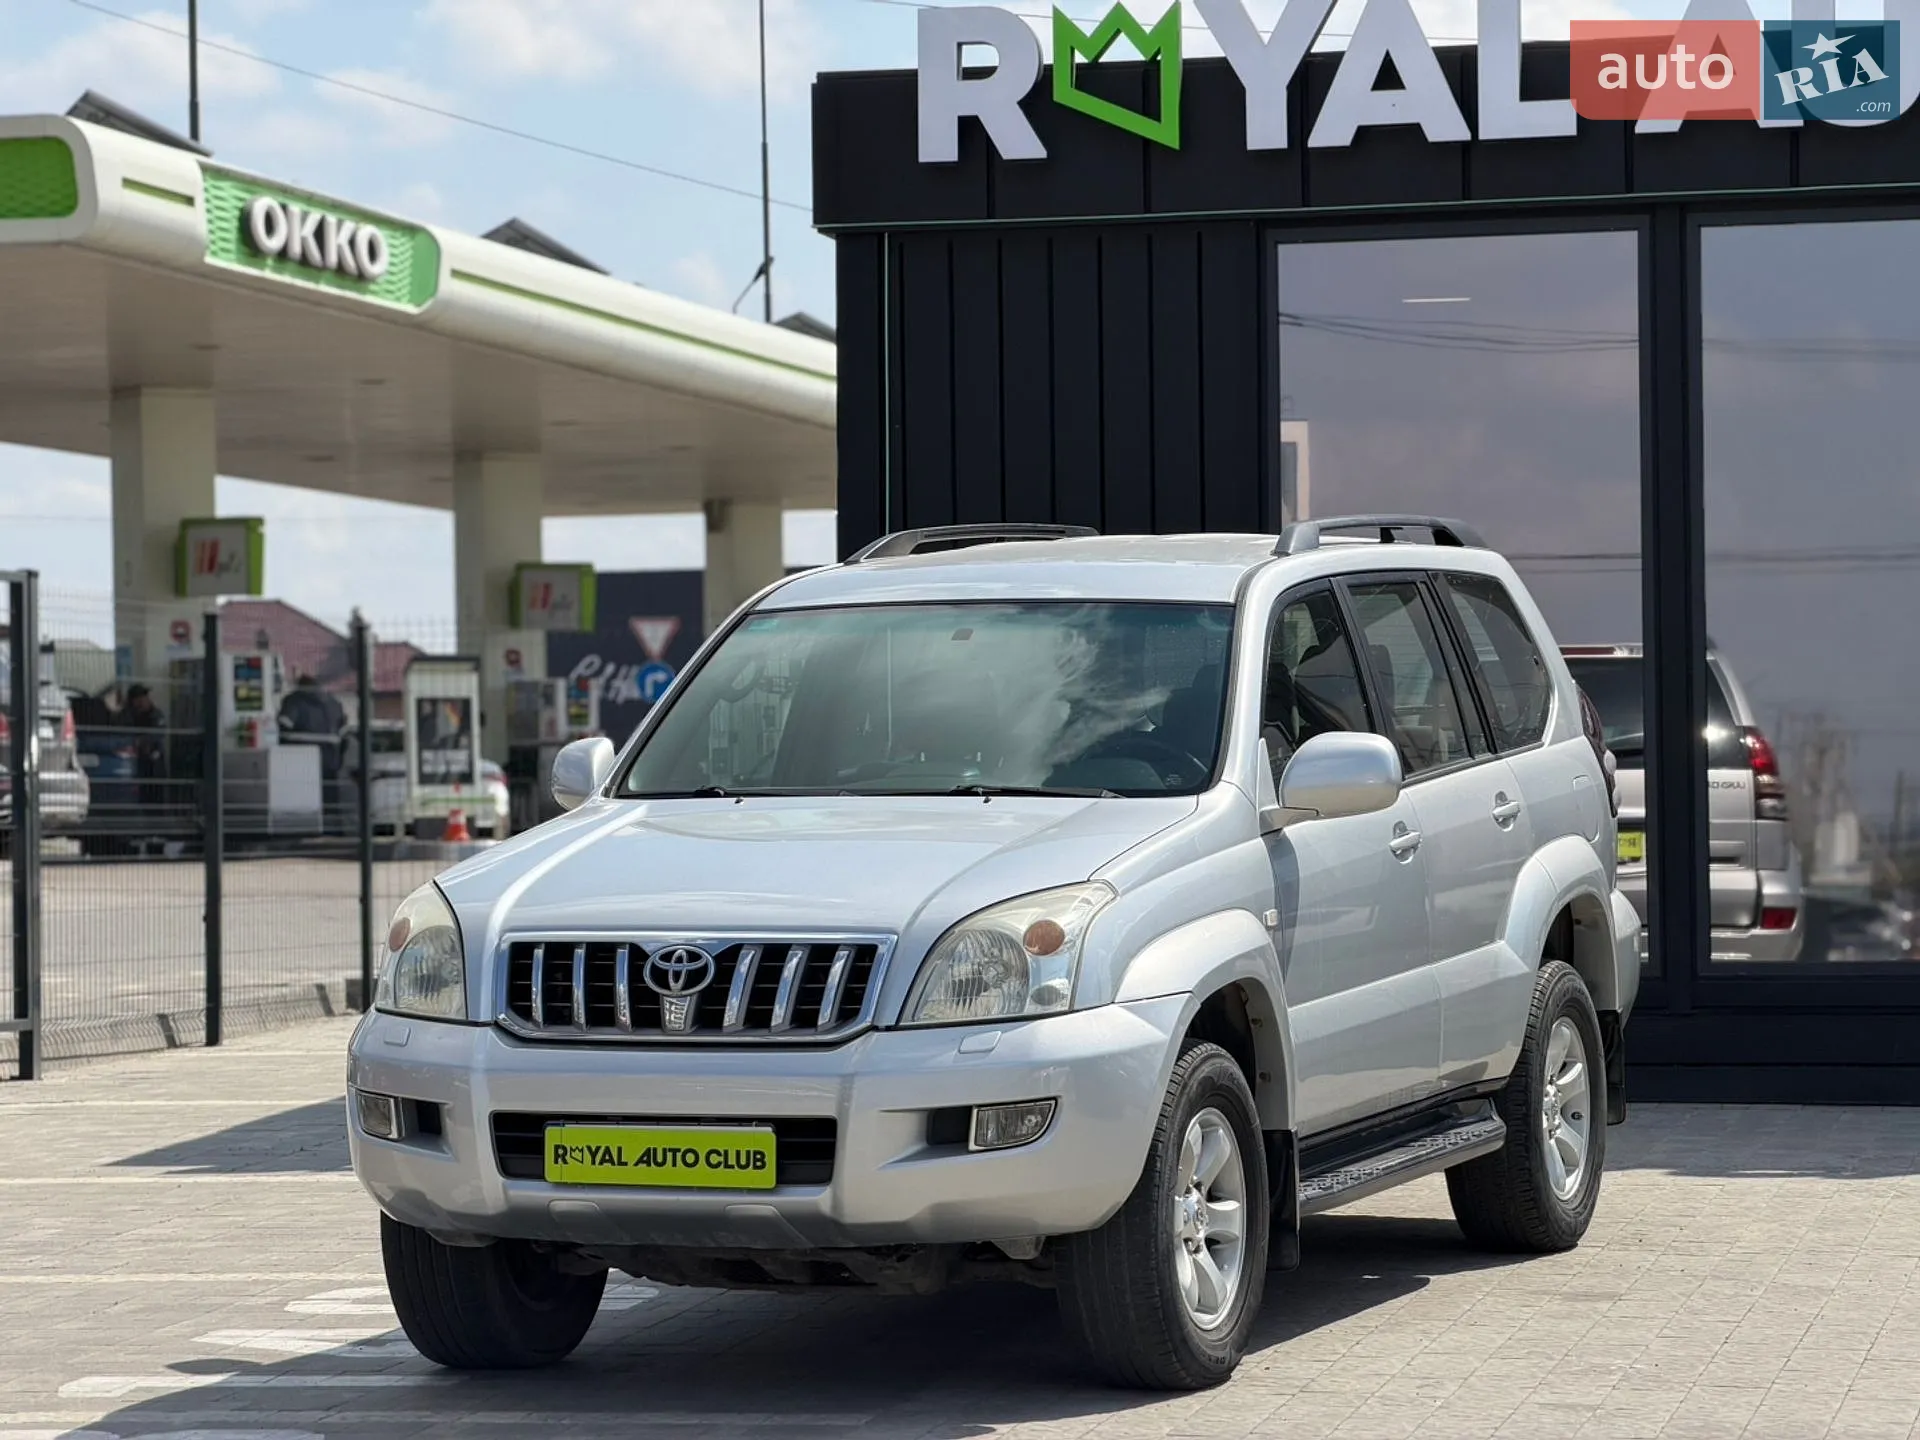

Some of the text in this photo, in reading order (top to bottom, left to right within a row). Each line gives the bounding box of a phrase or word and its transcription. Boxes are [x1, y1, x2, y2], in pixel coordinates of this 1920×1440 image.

[250, 196, 389, 280] OKKO
[633, 1145, 700, 1169] AUTO
[704, 1148, 767, 1171] CLUB
